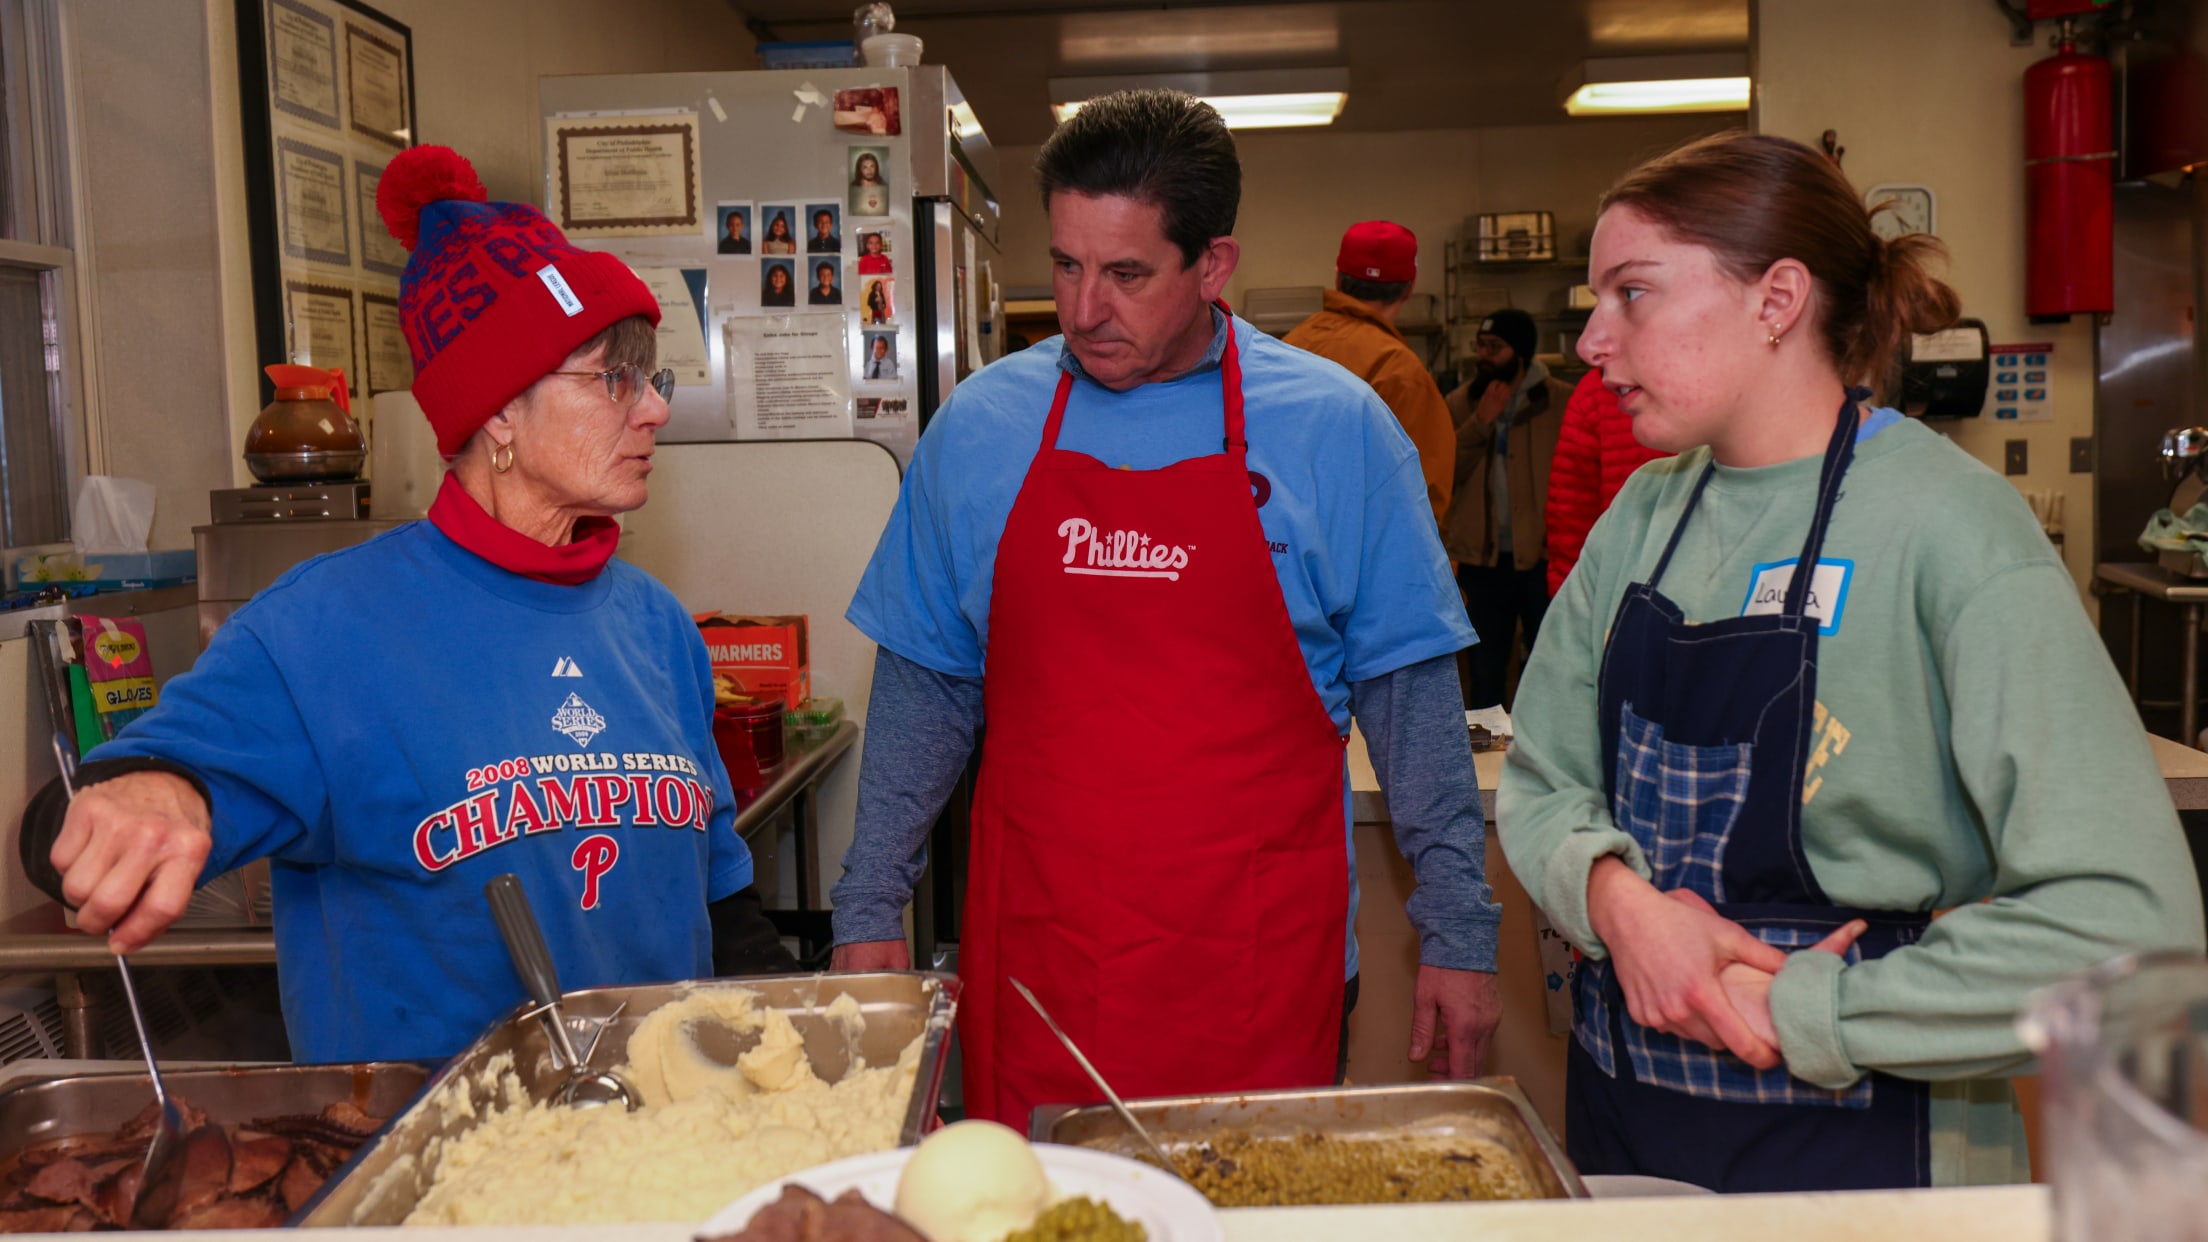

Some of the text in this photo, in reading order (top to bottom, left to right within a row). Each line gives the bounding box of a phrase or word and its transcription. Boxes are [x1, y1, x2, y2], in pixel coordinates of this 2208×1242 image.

[1754, 582, 1820, 609] Laua
[708, 643, 782, 662] WARMERS
[557, 707, 596, 718] WORLD
[551, 714, 606, 732] SERIES
[466, 752, 699, 791] 2008 WORLD SERIES
